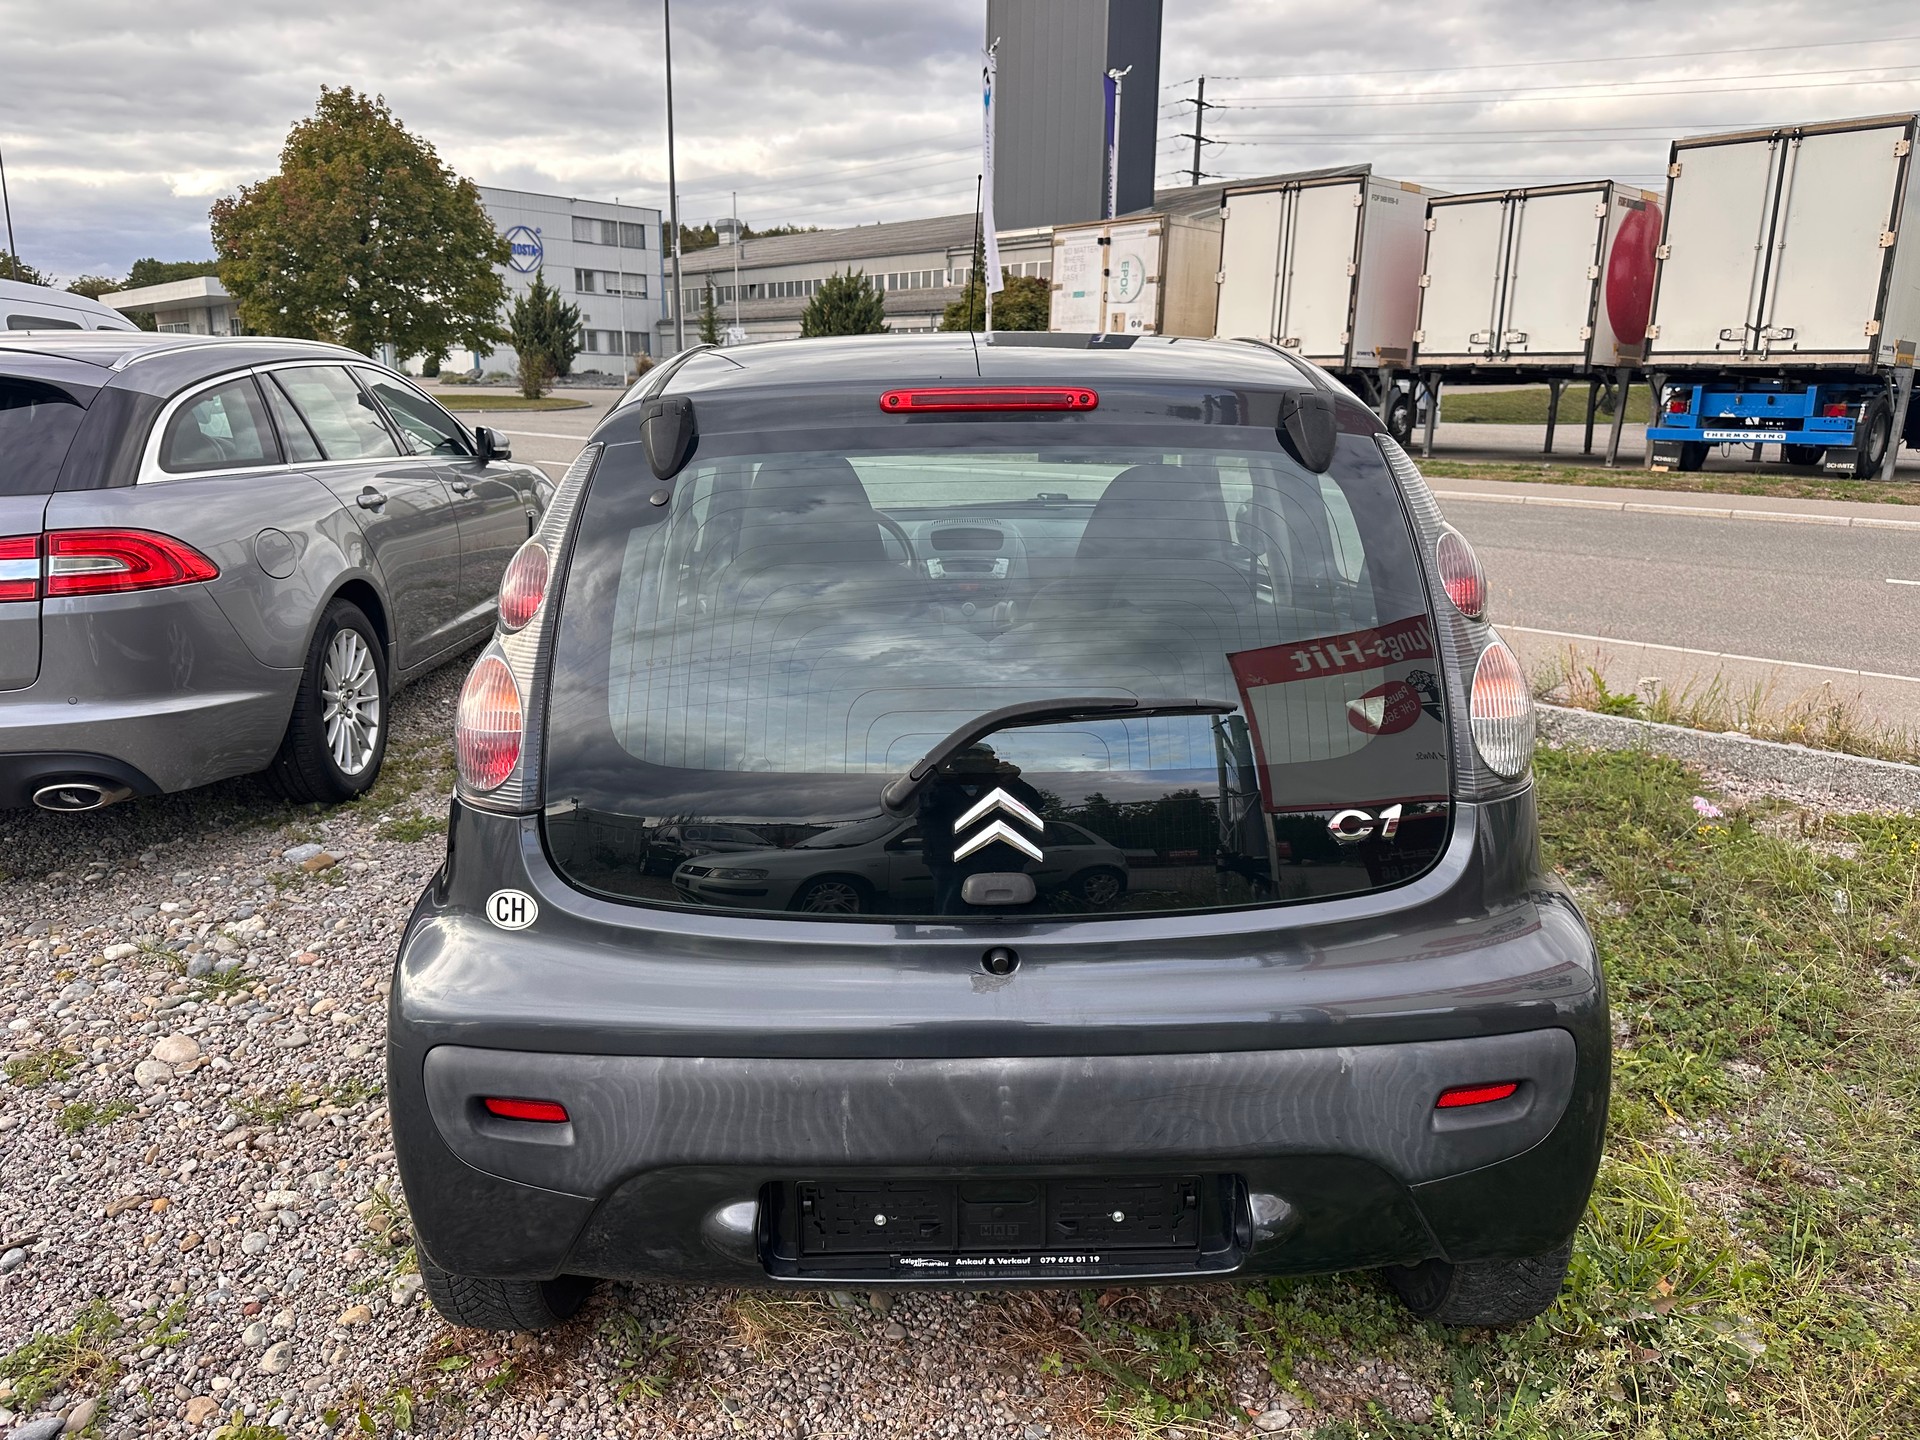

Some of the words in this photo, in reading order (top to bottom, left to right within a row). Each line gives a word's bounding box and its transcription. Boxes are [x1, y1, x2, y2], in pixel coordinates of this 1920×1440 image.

[1120, 261, 1130, 296] EPOK
[1653, 455, 1679, 464] SCHMITZ
[1826, 462, 1855, 470] SCHMITZ
[1327, 803, 1403, 845] C1
[497, 896, 525, 922] CH
[997, 1257, 1031, 1265] Verkauf
[1058, 1256, 1074, 1264] 678
[1089, 1255, 1100, 1263] 19
